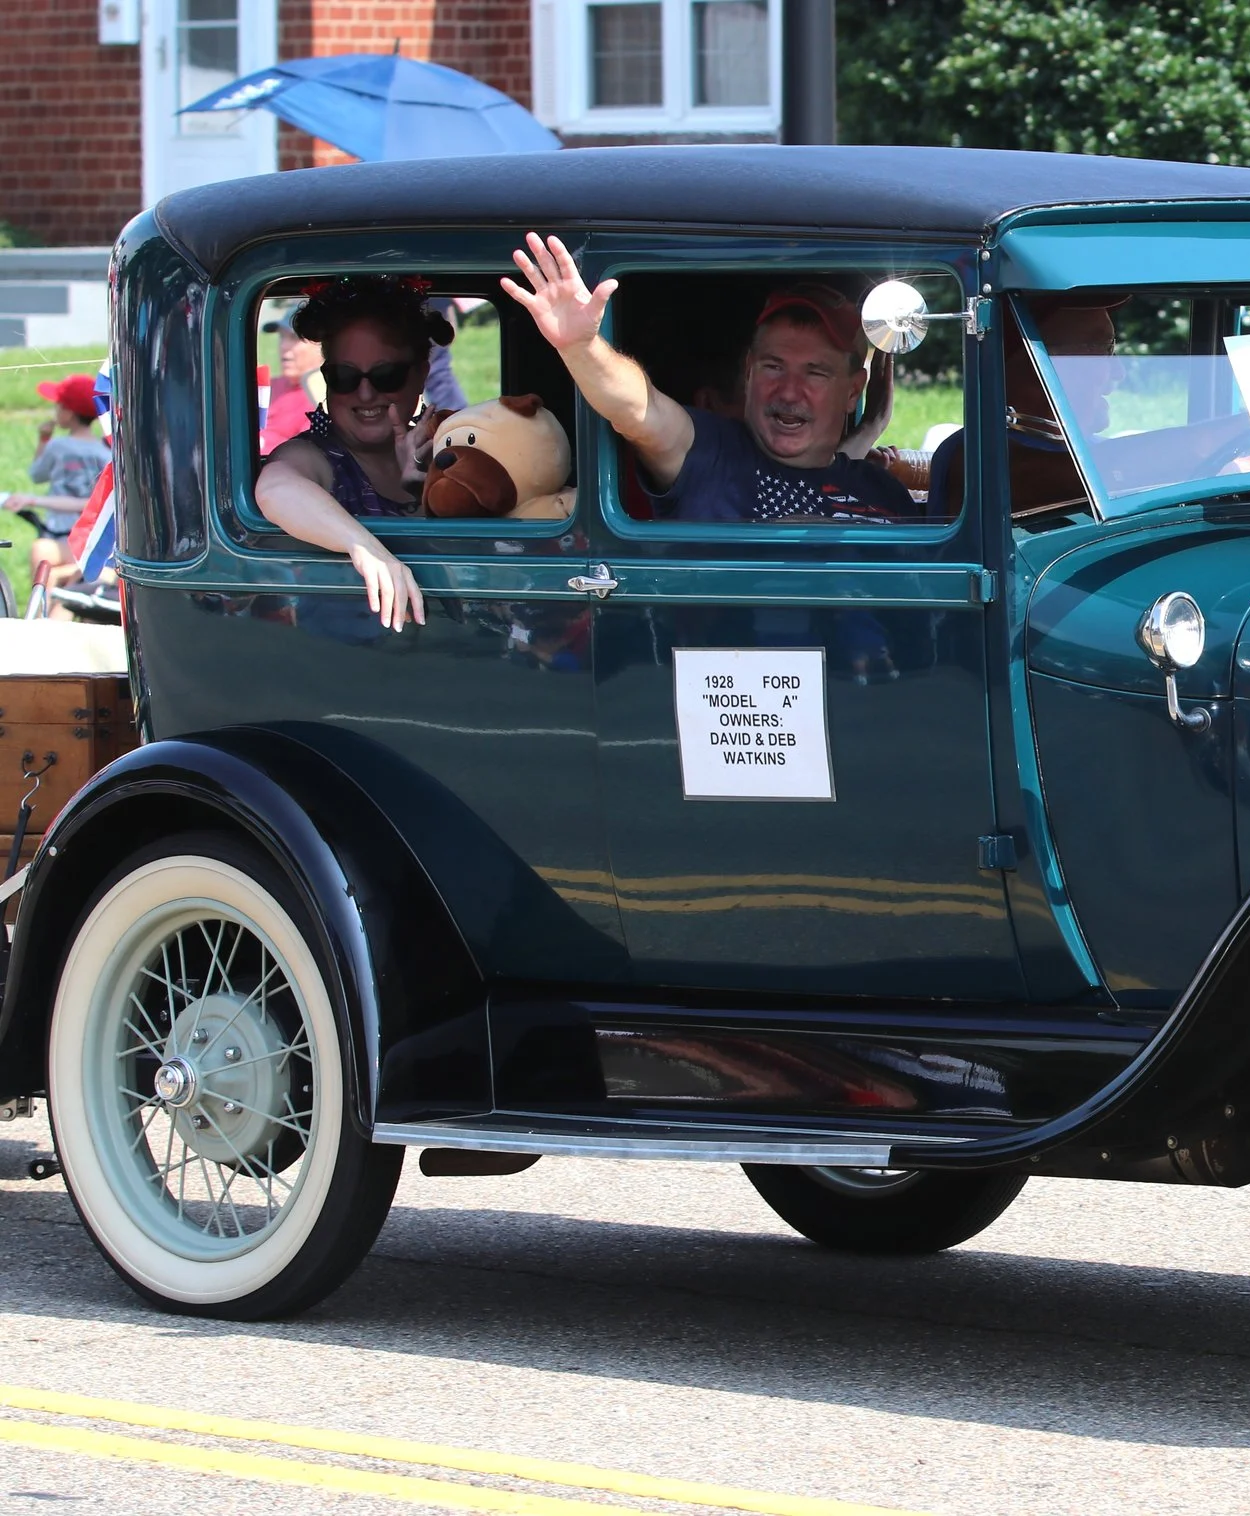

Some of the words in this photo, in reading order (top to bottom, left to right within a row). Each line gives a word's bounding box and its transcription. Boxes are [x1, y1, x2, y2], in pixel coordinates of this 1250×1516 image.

[704, 675, 734, 689] 1928
[763, 675, 801, 689] FORD
[702, 694, 757, 708] "MODEL
[782, 695, 798, 708] A"
[719, 713, 783, 727] OWNERS:
[710, 732, 751, 746] DAVID
[755, 732, 765, 746] &
[768, 733, 797, 747] DEB
[723, 751, 786, 766] WATKINS
